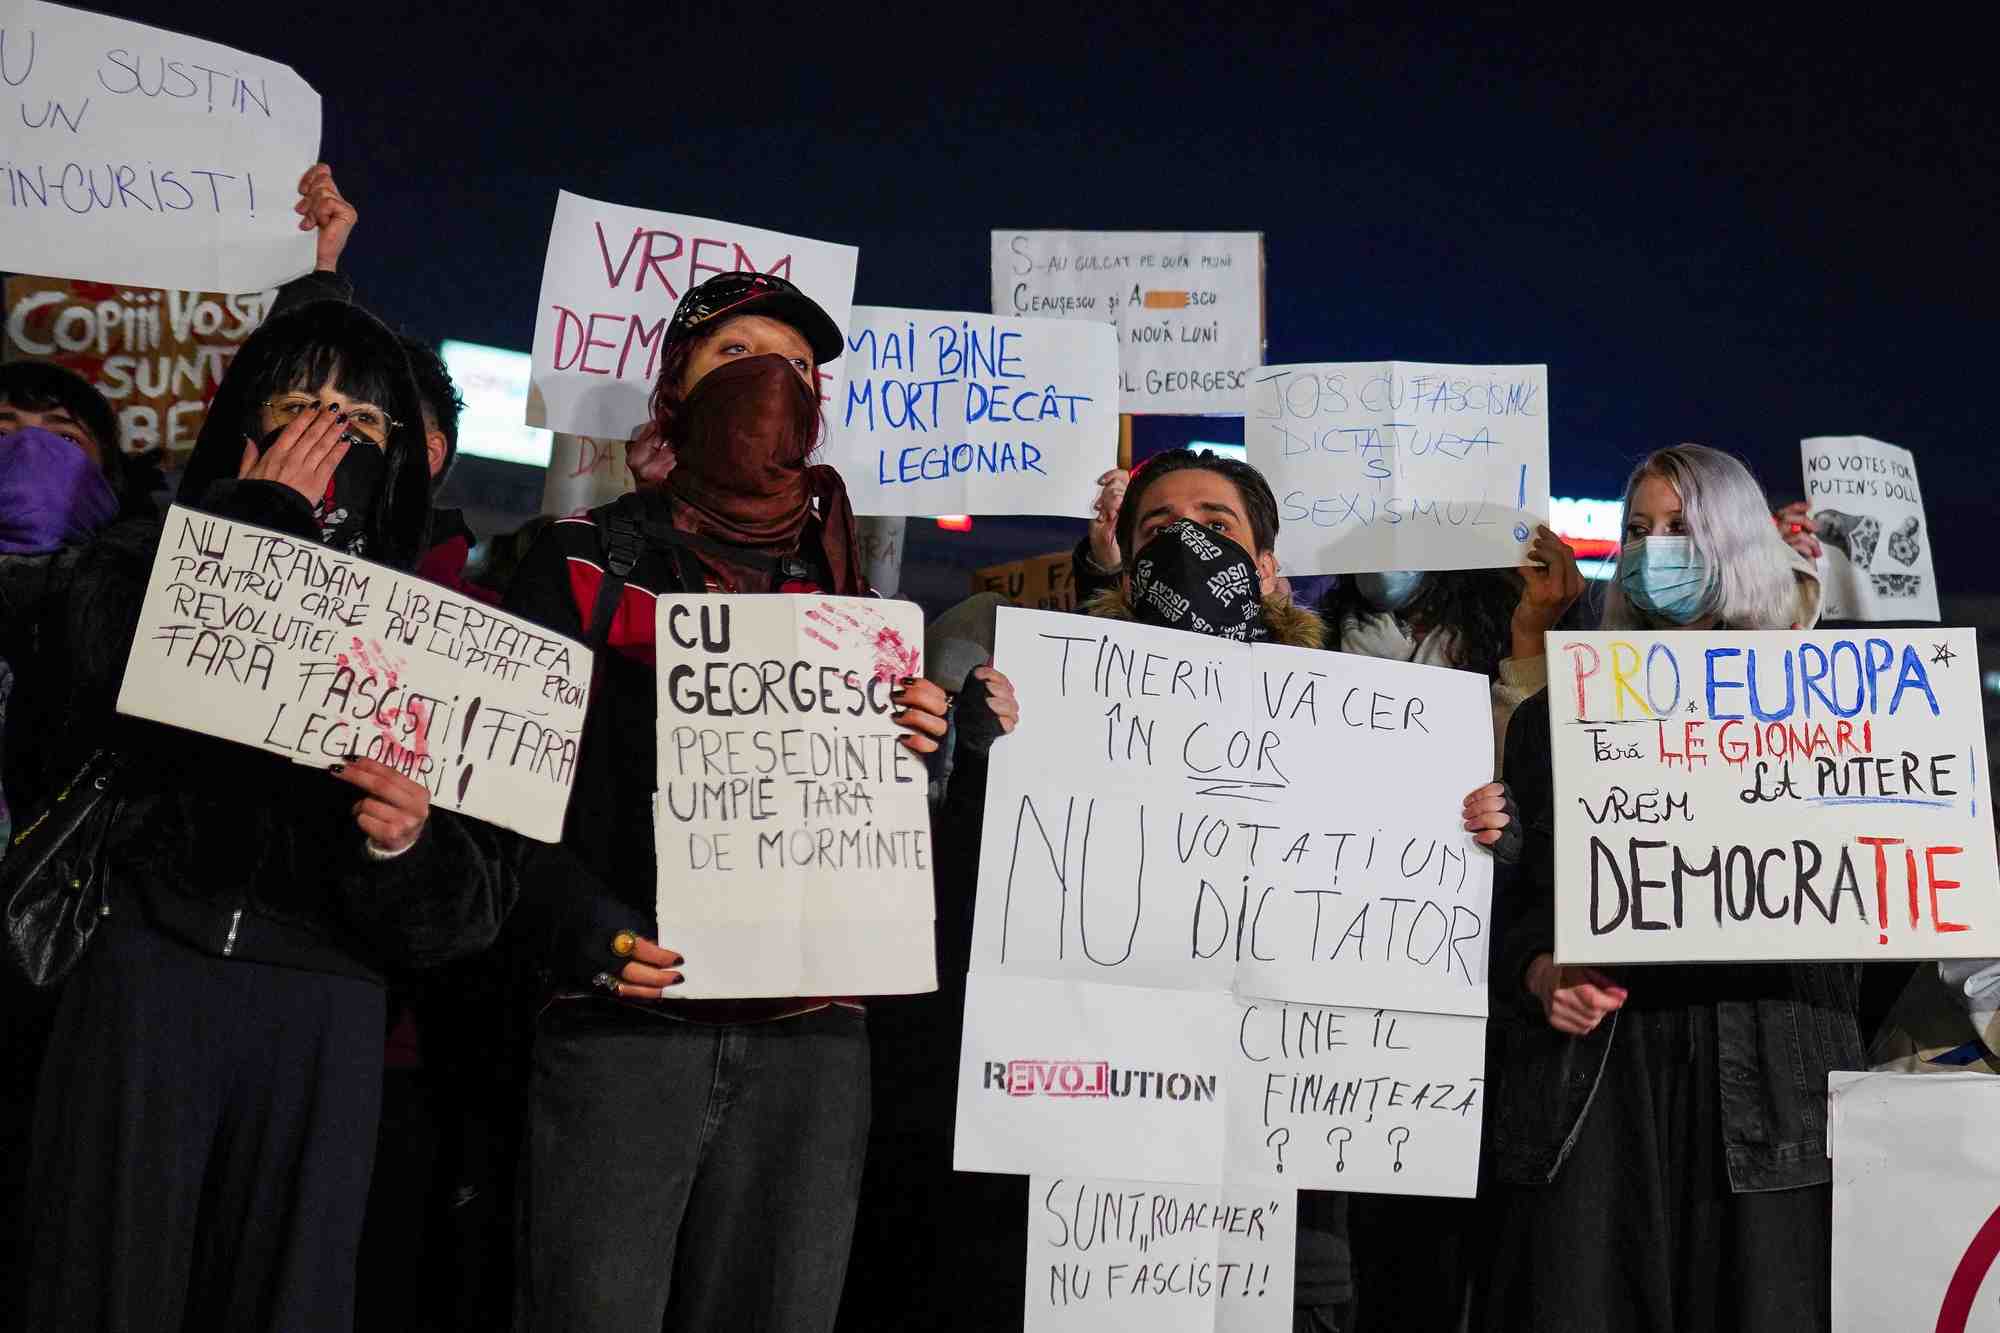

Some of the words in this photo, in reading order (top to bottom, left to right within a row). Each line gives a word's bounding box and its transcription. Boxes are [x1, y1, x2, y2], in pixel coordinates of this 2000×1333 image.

[21, 98, 89, 133] UN
[0, 160, 255, 218] IN-CURIST!
[929, 320, 1026, 379] BINE
[845, 379, 959, 432] MORT
[966, 382, 1094, 425] DECÂT
[1145, 368, 1247, 396] GEORGESC
[1256, 371, 1349, 419] JOS
[1359, 370, 1404, 412] CU
[879, 441, 1047, 485] LEGIONAR
[1272, 424, 1504, 461] DICTATURA
[1808, 455, 1831, 472] NO
[1838, 455, 1887, 474] VOTES
[1809, 478, 1878, 496] PUTIN'S
[1885, 482, 1918, 504] DOLL
[171, 556, 283, 602] PENTRU
[300, 592, 370, 627] CARE
[385, 614, 419, 646] AU
[426, 630, 530, 681] LUPTAT
[178, 517, 232, 560] NU
[243, 534, 370, 602] TRĂDĂM
[386, 581, 571, 676] LIBERTATEA
[668, 603, 730, 654] CU
[1038, 633, 1224, 704] TINERII
[1263, 671, 1328, 727] VĂ
[1342, 687, 1430, 733] CER
[1704, 637, 1940, 721] EUROPA
[1104, 703, 1155, 766] ÎN
[1183, 722, 1290, 784] COR
[1658, 720, 1873, 774] LEGIONARI
[668, 777, 778, 823] UMPLE
[1578, 785, 1695, 825] VREM
[689, 832, 735, 871] DE
[758, 821, 928, 871] MORMINTE
[1000, 793, 1146, 966] NU
[1399, 837, 1468, 893] UN
[1192, 874, 1482, 987] DICTATOR
[1239, 1002, 1347, 1062] CINE
[1372, 1008, 1411, 1050] ÎL
[1046, 1179, 1146, 1251] SUNT
[1049, 1264, 1090, 1306] NU
